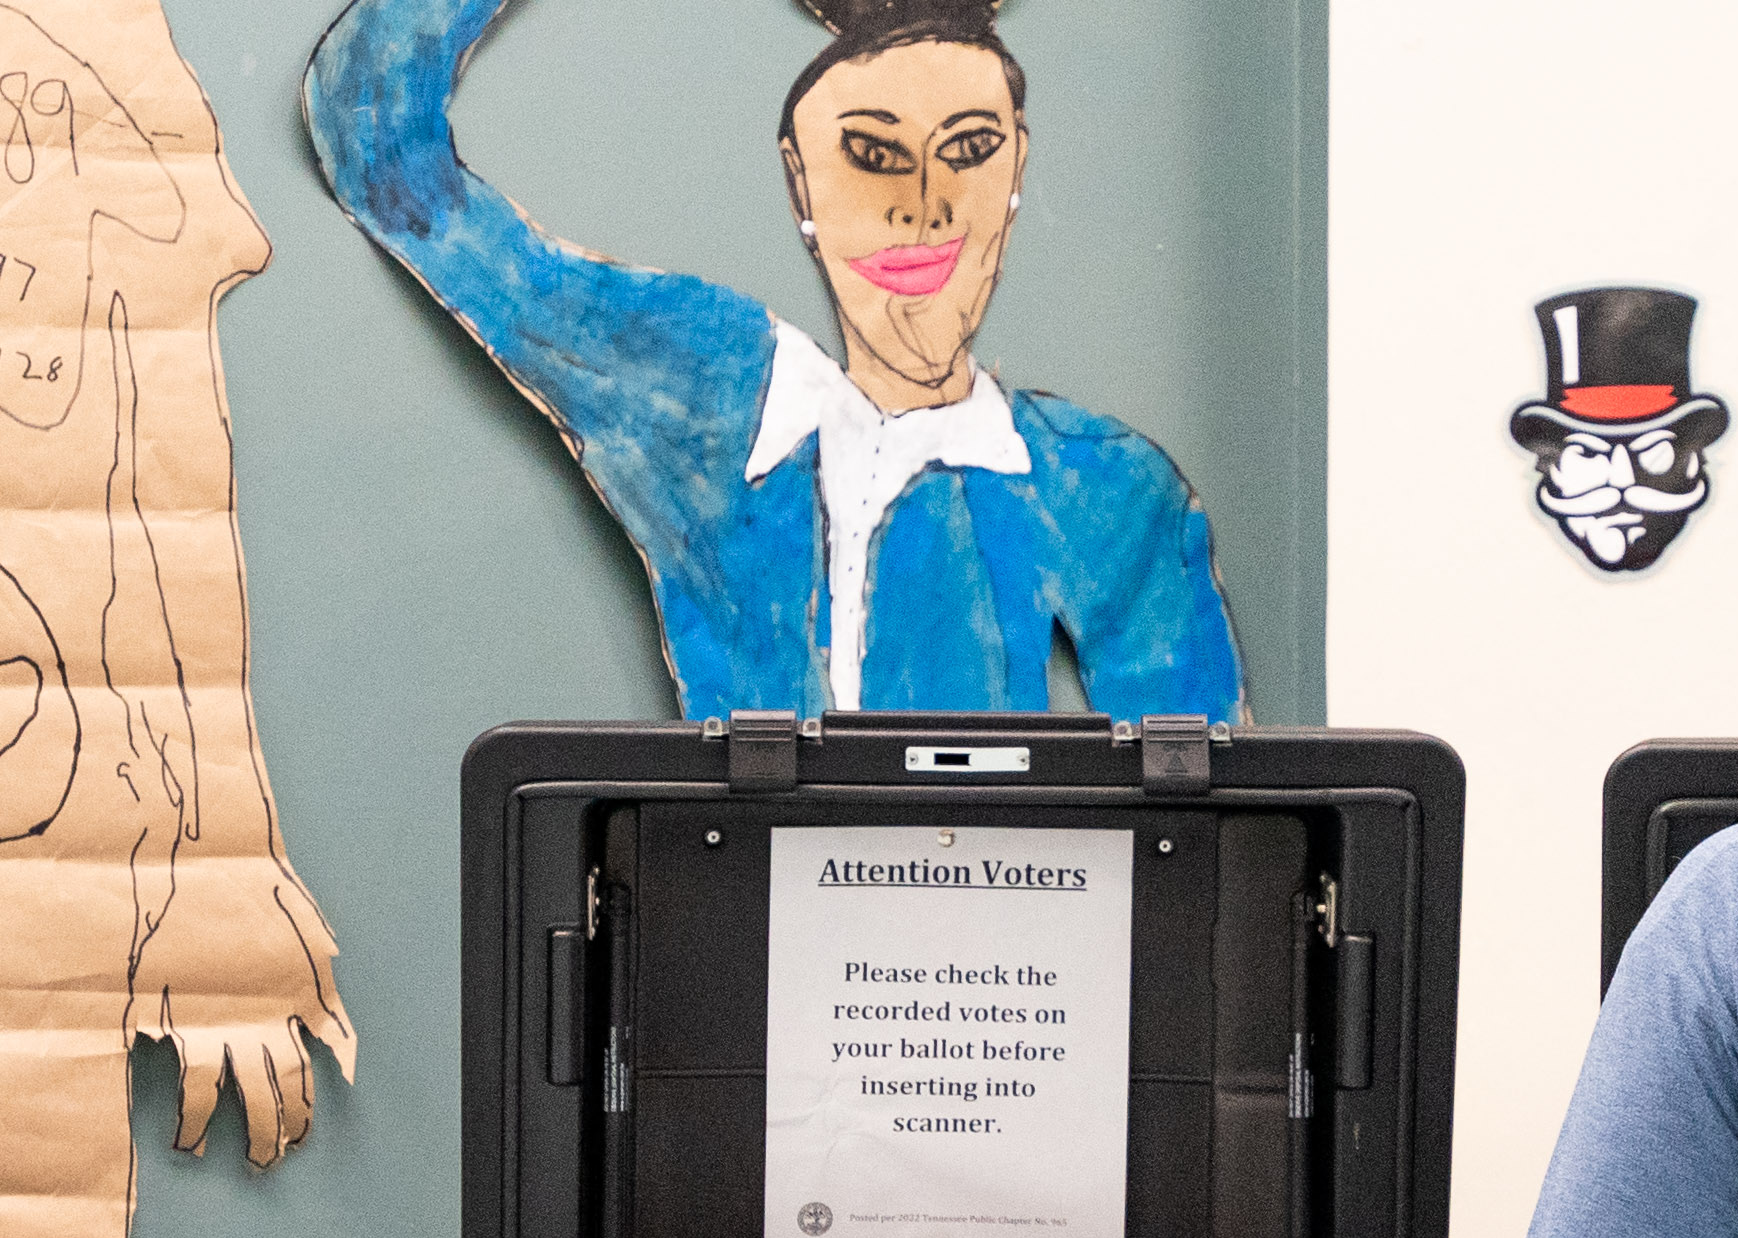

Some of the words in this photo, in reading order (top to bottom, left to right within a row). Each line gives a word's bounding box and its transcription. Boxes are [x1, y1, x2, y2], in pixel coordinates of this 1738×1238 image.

[818, 858, 972, 886] Attention
[982, 860, 1088, 888] Voters
[844, 961, 927, 985] Please
[935, 963, 1010, 986] check
[1016, 965, 1058, 987] the
[832, 1000, 951, 1023] recorded
[959, 1005, 1027, 1024] votes
[1034, 1009, 1067, 1025] on
[831, 1042, 893, 1063] your
[900, 1038, 975, 1060] ballot
[982, 1041, 1067, 1062] before
[860, 1074, 978, 1101] inserting
[985, 1077, 1036, 1099] into
[893, 1114, 1002, 1134] scanner.
[849, 1213, 879, 1223] Posted
[880, 1215, 895, 1224] per
